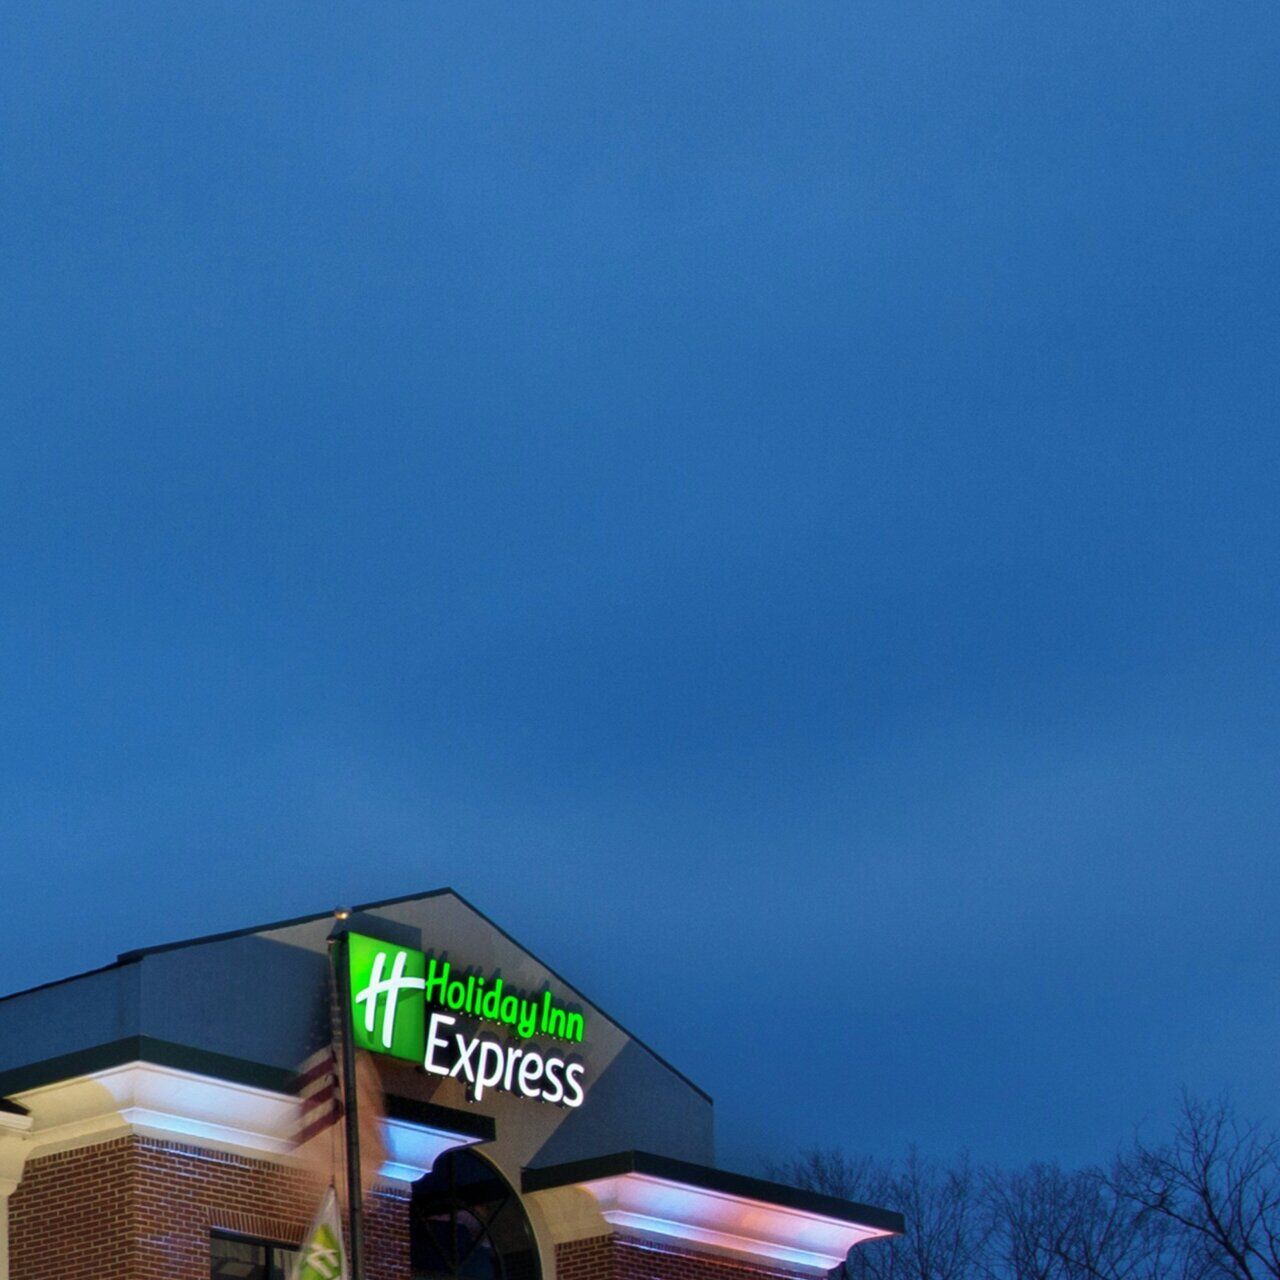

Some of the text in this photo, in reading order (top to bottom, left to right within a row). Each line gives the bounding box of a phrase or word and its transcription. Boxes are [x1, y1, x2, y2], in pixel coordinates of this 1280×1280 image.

[425, 960, 584, 1042] Holiday Inn
[424, 1013, 585, 1108] Express
